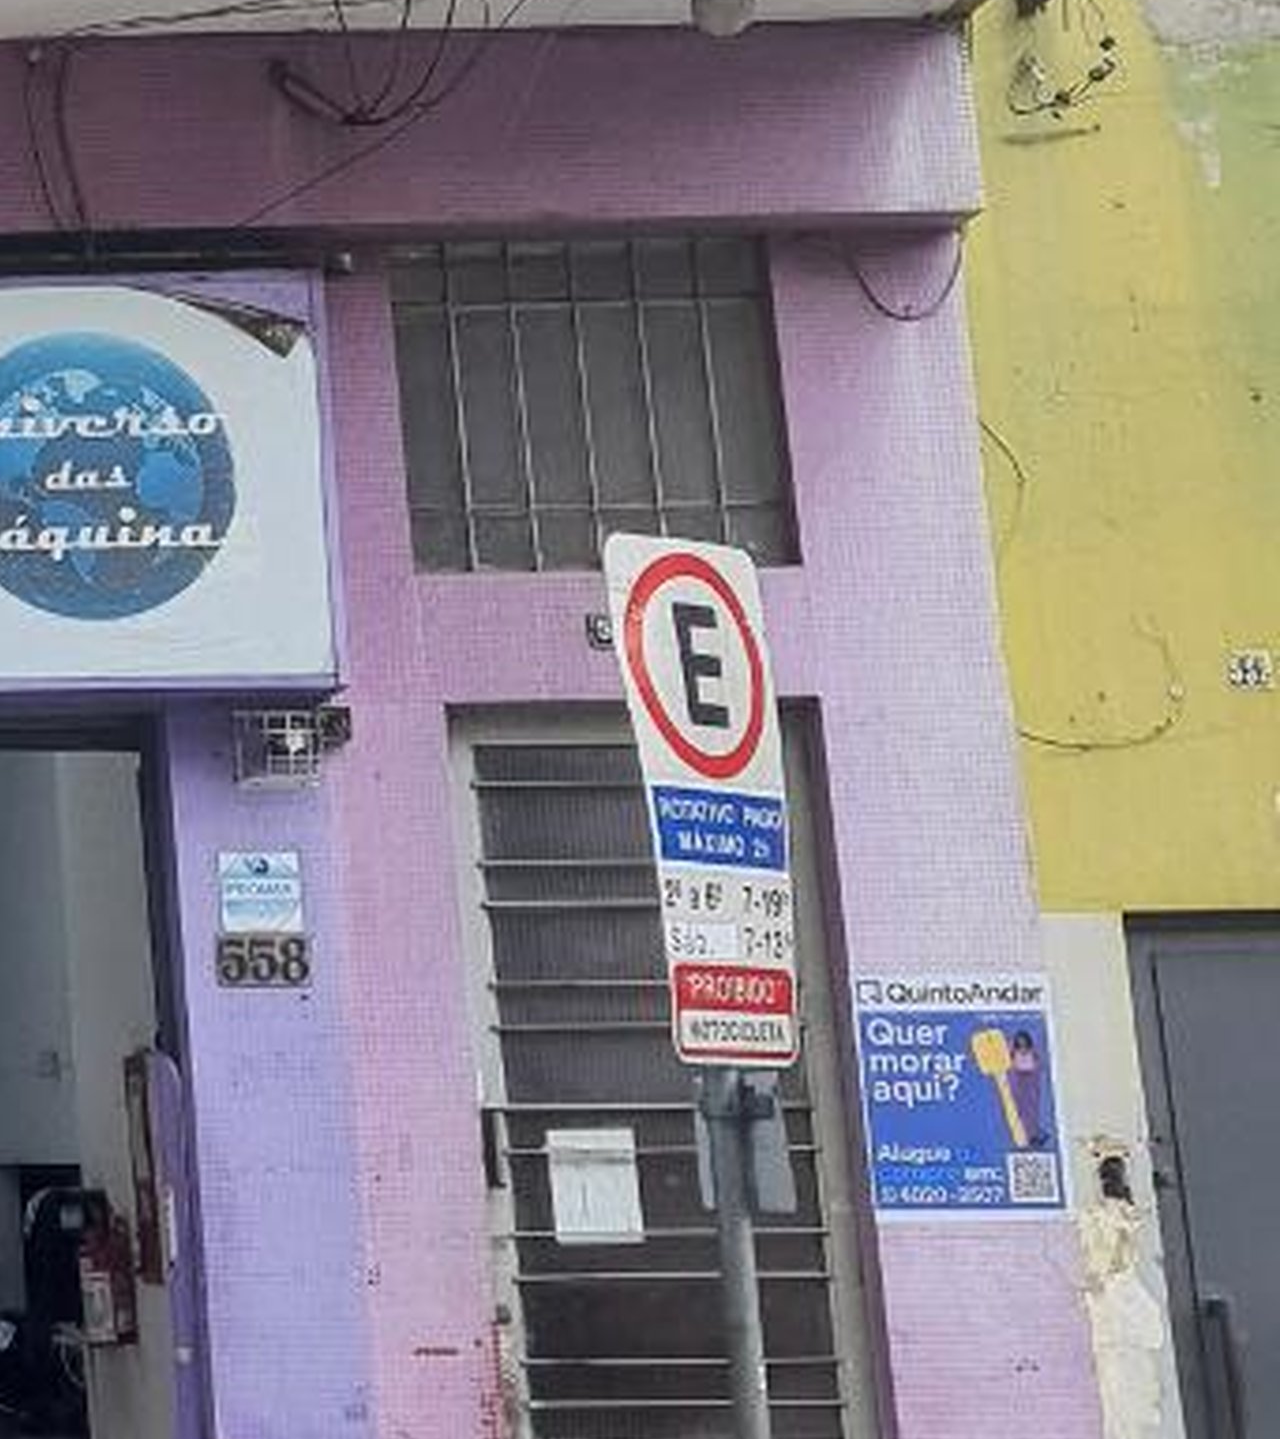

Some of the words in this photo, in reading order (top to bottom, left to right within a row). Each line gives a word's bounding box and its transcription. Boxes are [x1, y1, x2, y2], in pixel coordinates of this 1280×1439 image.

[44, 460, 133, 491] das
[671, 601, 731, 728] E
[218, 937, 310, 983] 558
[886, 981, 1043, 1004] QuintoAndar
[867, 1017, 948, 1047] Quer
[869, 1052, 967, 1073] morar
[873, 1075, 960, 1109] aqui?
